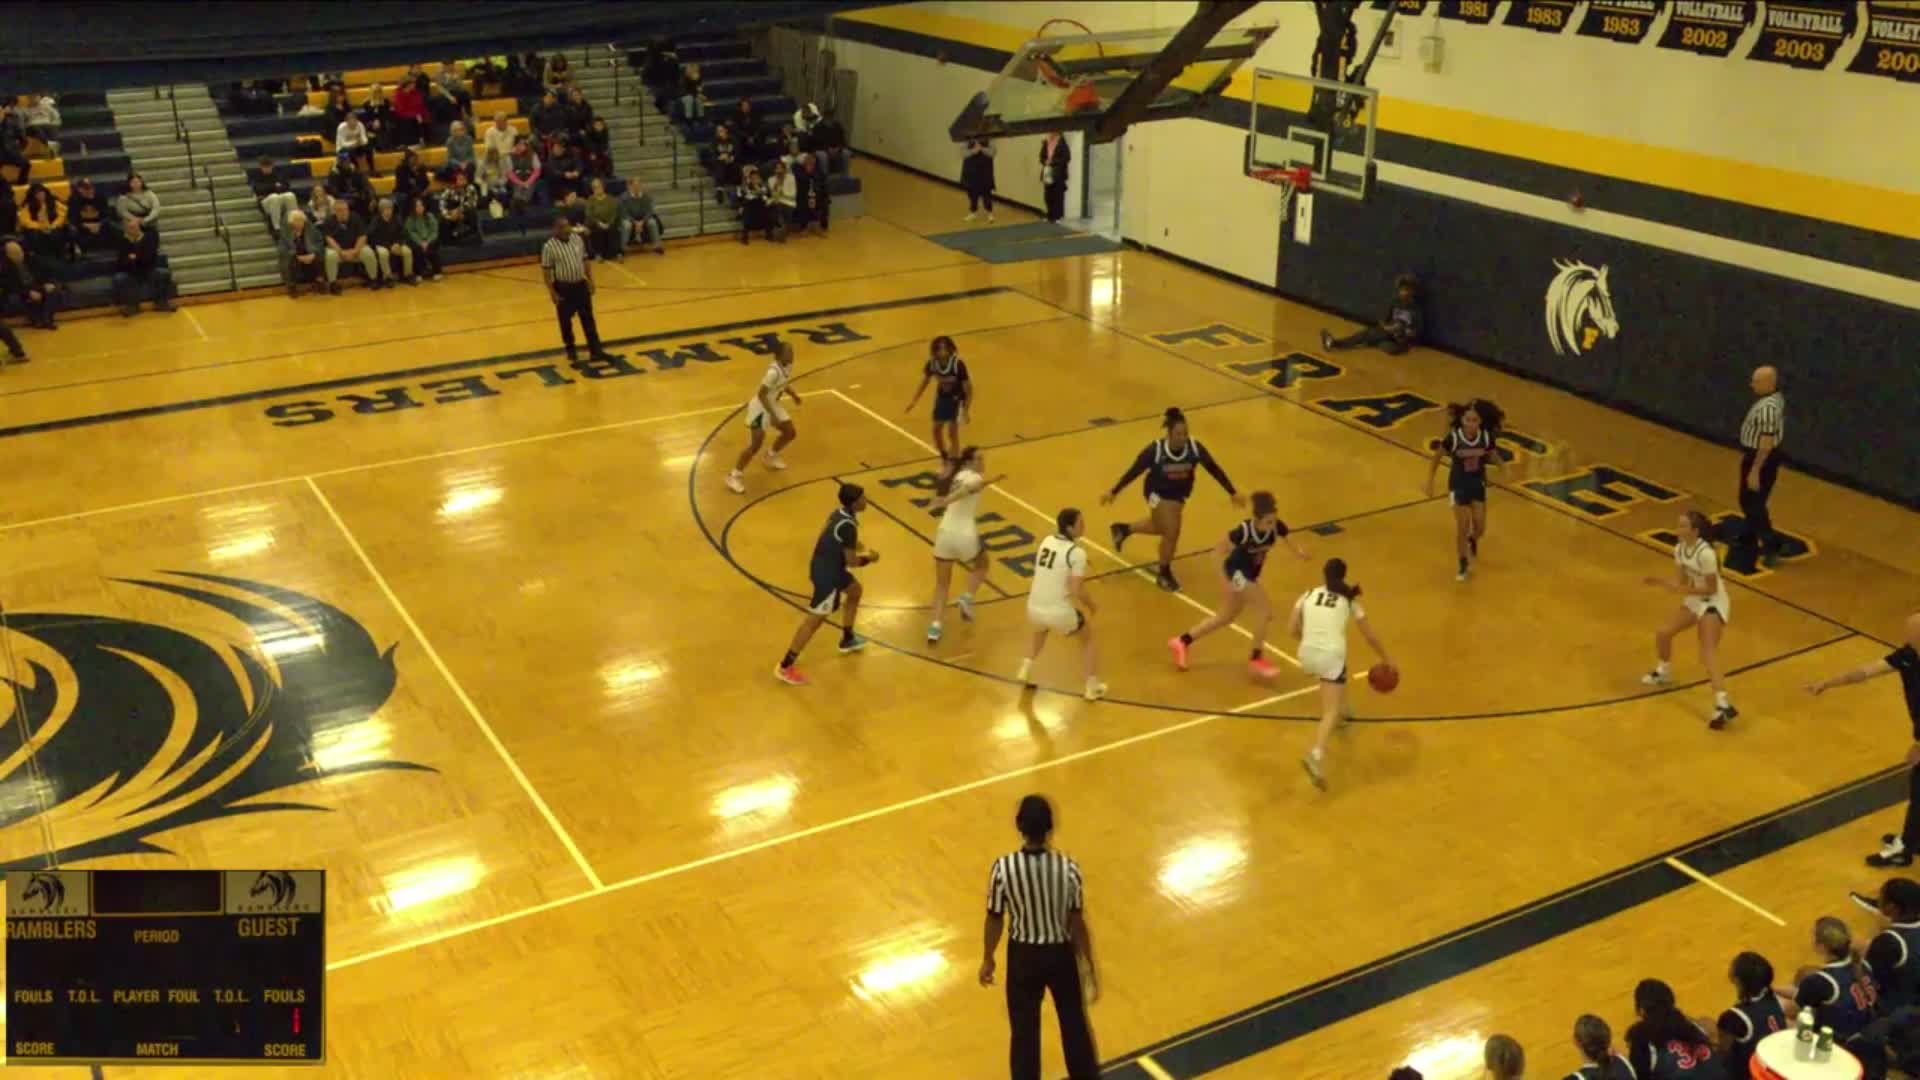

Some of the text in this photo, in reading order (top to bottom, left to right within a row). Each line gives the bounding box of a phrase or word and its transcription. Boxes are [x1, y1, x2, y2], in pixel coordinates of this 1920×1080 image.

[1458, 1, 1489, 17] 1981
[1526, 7, 1562, 26] 1983
[1675, 0, 1744, 21] VOLLEYBALL
[1603, 16, 1640, 35] 1983
[1768, 10, 1843, 32] VOLLEYBALL
[1871, 20, 1920, 41] VOLLEY
[1681, 27, 1728, 48] 2002
[1775, 38, 1825, 61] 2003
[1877, 49, 1920, 73] 200
[263, 320, 872, 427] RAMBLERS
[1039, 548, 1057, 569] 21
[1315, 592, 1339, 608] 12
